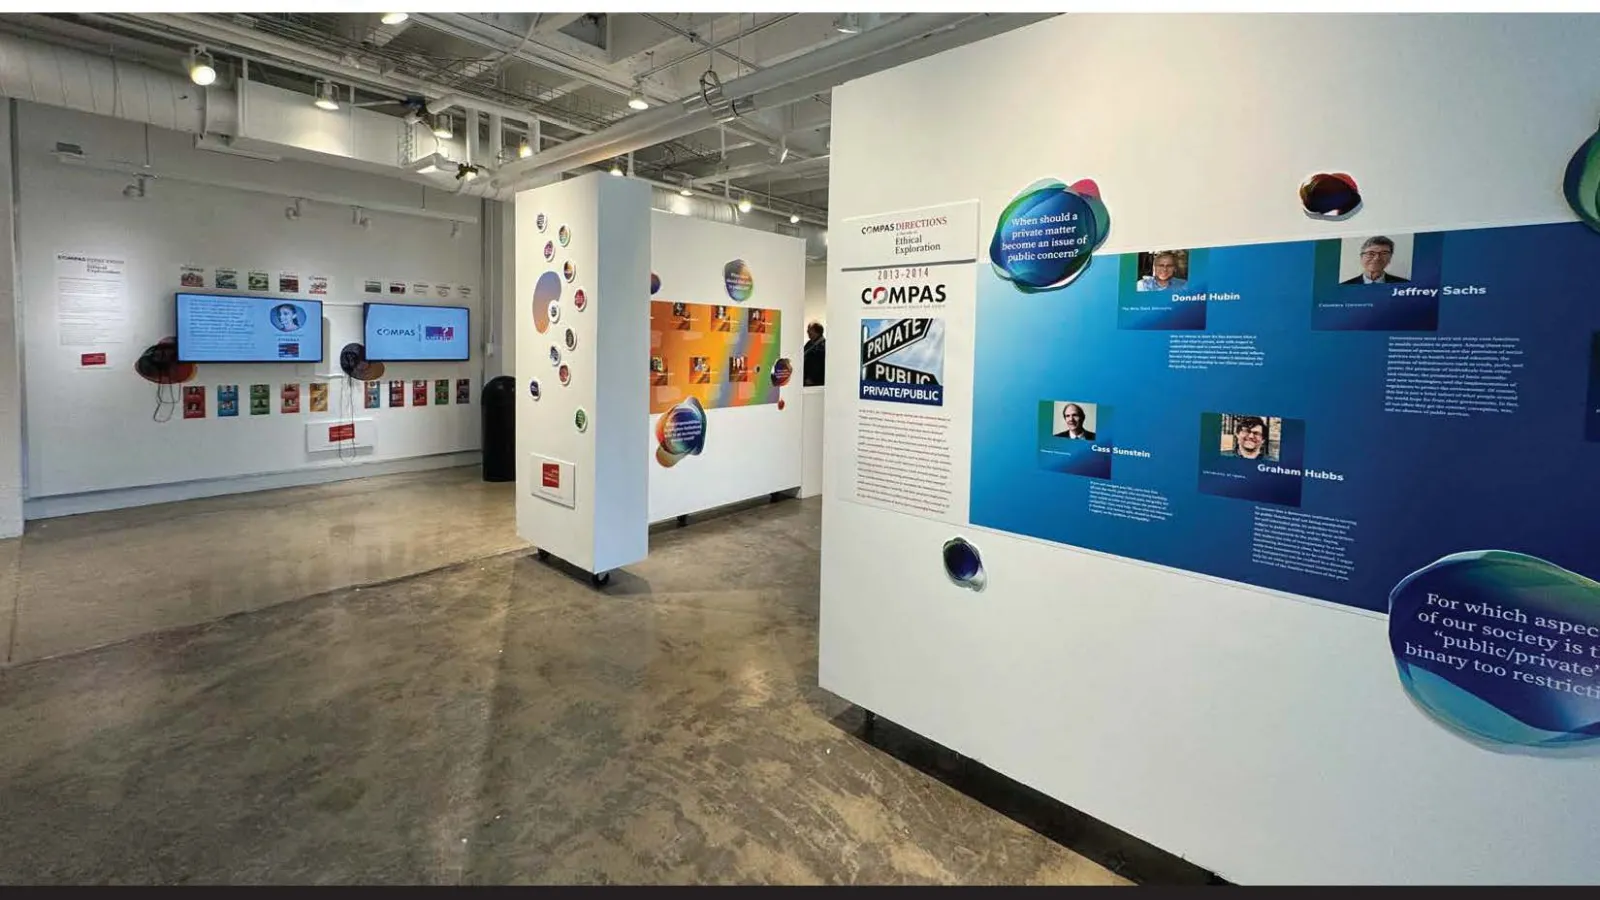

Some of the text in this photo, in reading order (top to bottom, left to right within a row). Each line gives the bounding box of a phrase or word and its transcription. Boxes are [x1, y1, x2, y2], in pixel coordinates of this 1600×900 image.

[861, 223, 895, 235] COMPAS
[895, 216, 947, 231] DIRECTIONS
[1012, 212, 1078, 226] When should a
[895, 234, 922, 246] Ethical
[1012, 226, 1077, 240] private matter
[895, 243, 941, 256] Exploration
[1002, 234, 1088, 251] become an issue of
[1007, 248, 1079, 263] public concern?
[877, 267, 929, 280] 2013-2014
[861, 284, 947, 305] COMPAS
[1171, 292, 1240, 302] Donald Hubin
[1391, 285, 1487, 298] Jeffrey Sachs
[376, 328, 416, 337] COMPAS
[867, 318, 922, 358] PRIVATE
[863, 385, 939, 401] PRIVATE/PUBLIC
[1091, 444, 1151, 458] Cass Sunstein
[1257, 463, 1344, 482] Graham Hubbs
[1427, 592, 1599, 638] For which aspec
[1418, 611, 1600, 659] of our society is t
[1404, 641, 1470, 671] binary
[1474, 658, 1507, 677] too
